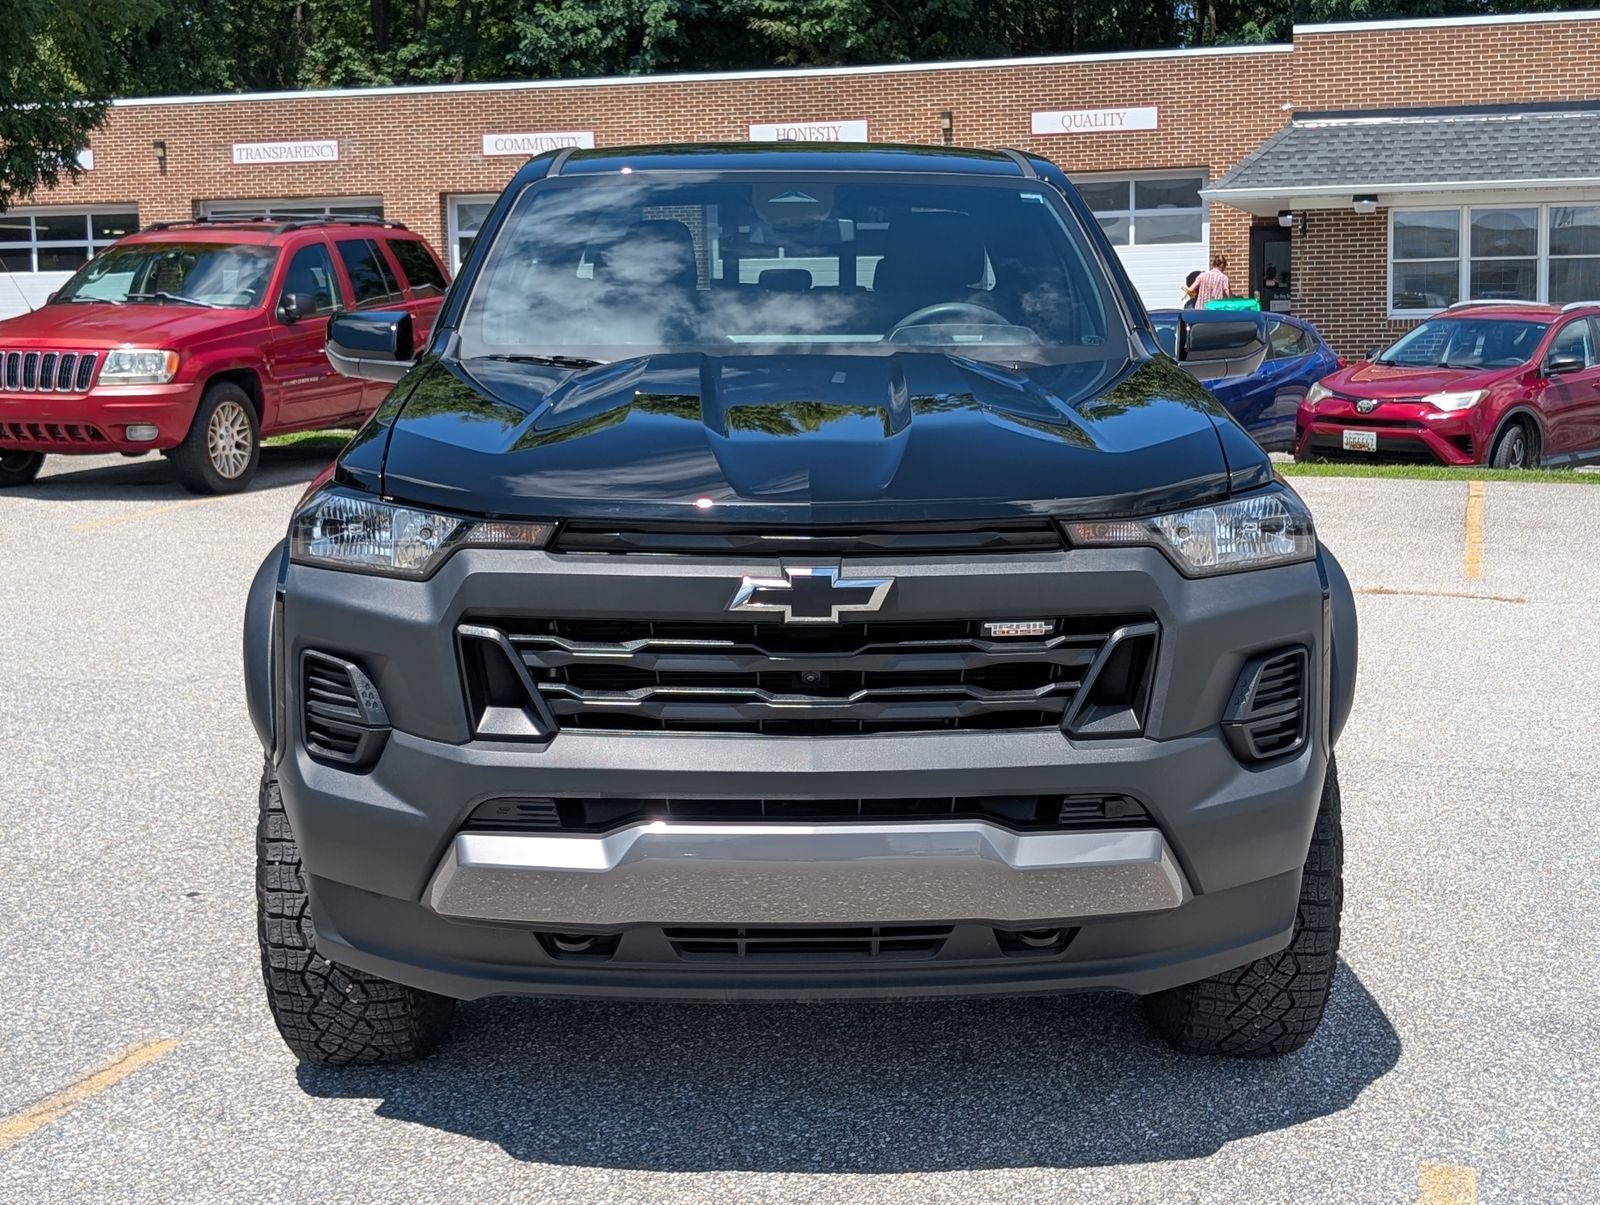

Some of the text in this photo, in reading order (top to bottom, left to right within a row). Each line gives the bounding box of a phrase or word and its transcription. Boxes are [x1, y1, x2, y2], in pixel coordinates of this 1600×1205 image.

[1061, 112, 1126, 132] QUALITY
[775, 125, 842, 141] HONESTY
[236, 144, 337, 160] TRANSPARENCY
[494, 136, 581, 152] COMMUNITY
[991, 629, 1045, 637] BOSS
